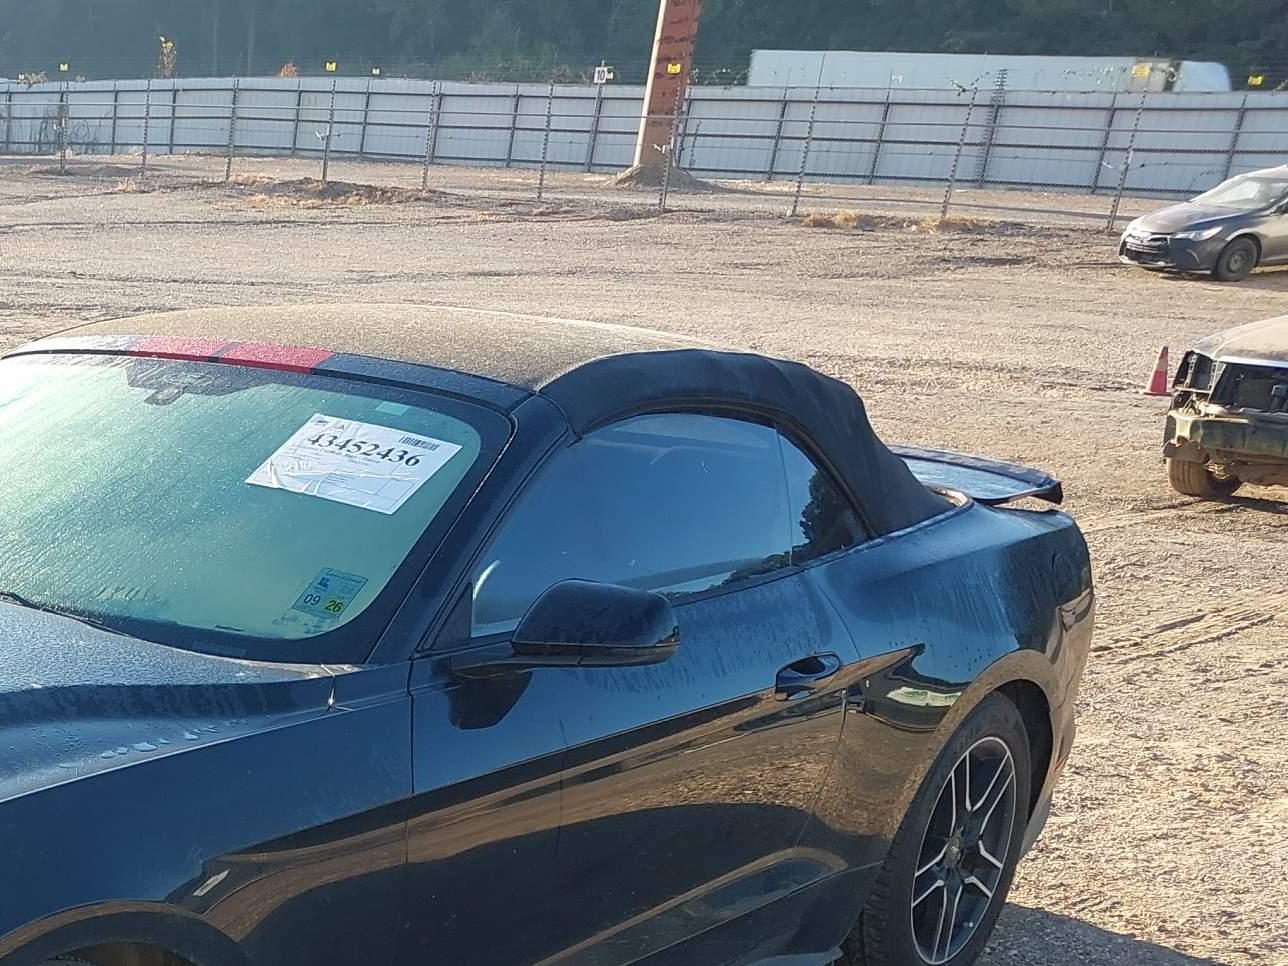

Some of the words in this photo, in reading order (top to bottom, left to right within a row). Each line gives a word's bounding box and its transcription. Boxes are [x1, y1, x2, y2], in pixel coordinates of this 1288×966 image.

[596, 69, 606, 81] 10
[308, 433, 422, 467] 43452436
[303, 594, 321, 606] 09
[325, 599, 344, 613] 26
